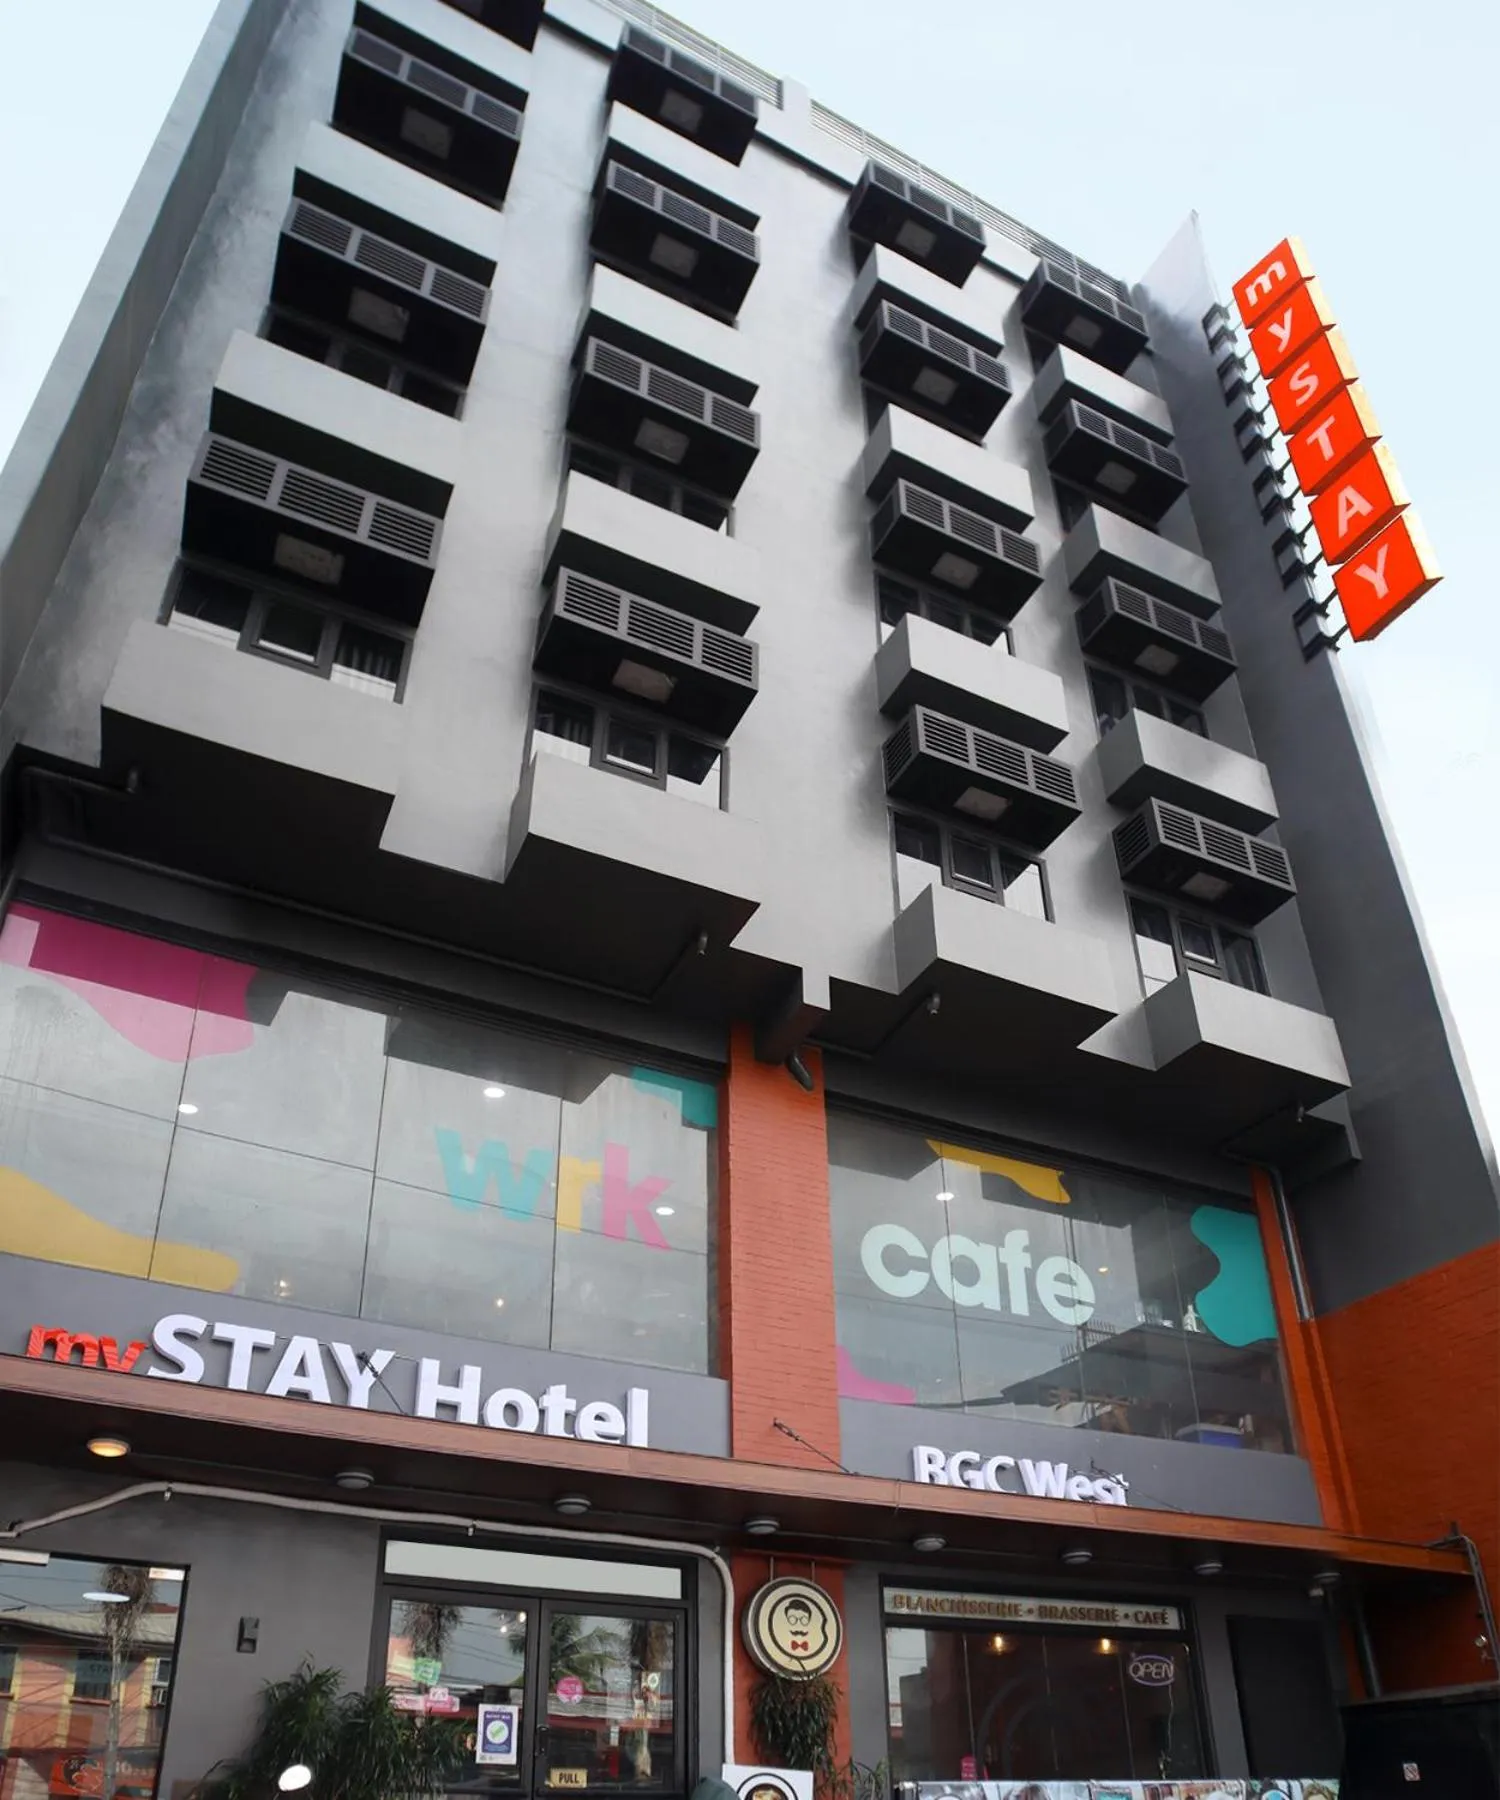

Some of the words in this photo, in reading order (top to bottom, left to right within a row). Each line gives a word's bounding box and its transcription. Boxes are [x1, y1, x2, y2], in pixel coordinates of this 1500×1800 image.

[434, 1126, 673, 1250] wrk
[860, 1223, 1096, 1326] cafe
[414, 1357, 650, 1448] Hotel
[1129, 1661, 1174, 1680] OPEN
[559, 1772, 579, 1784] PULL
